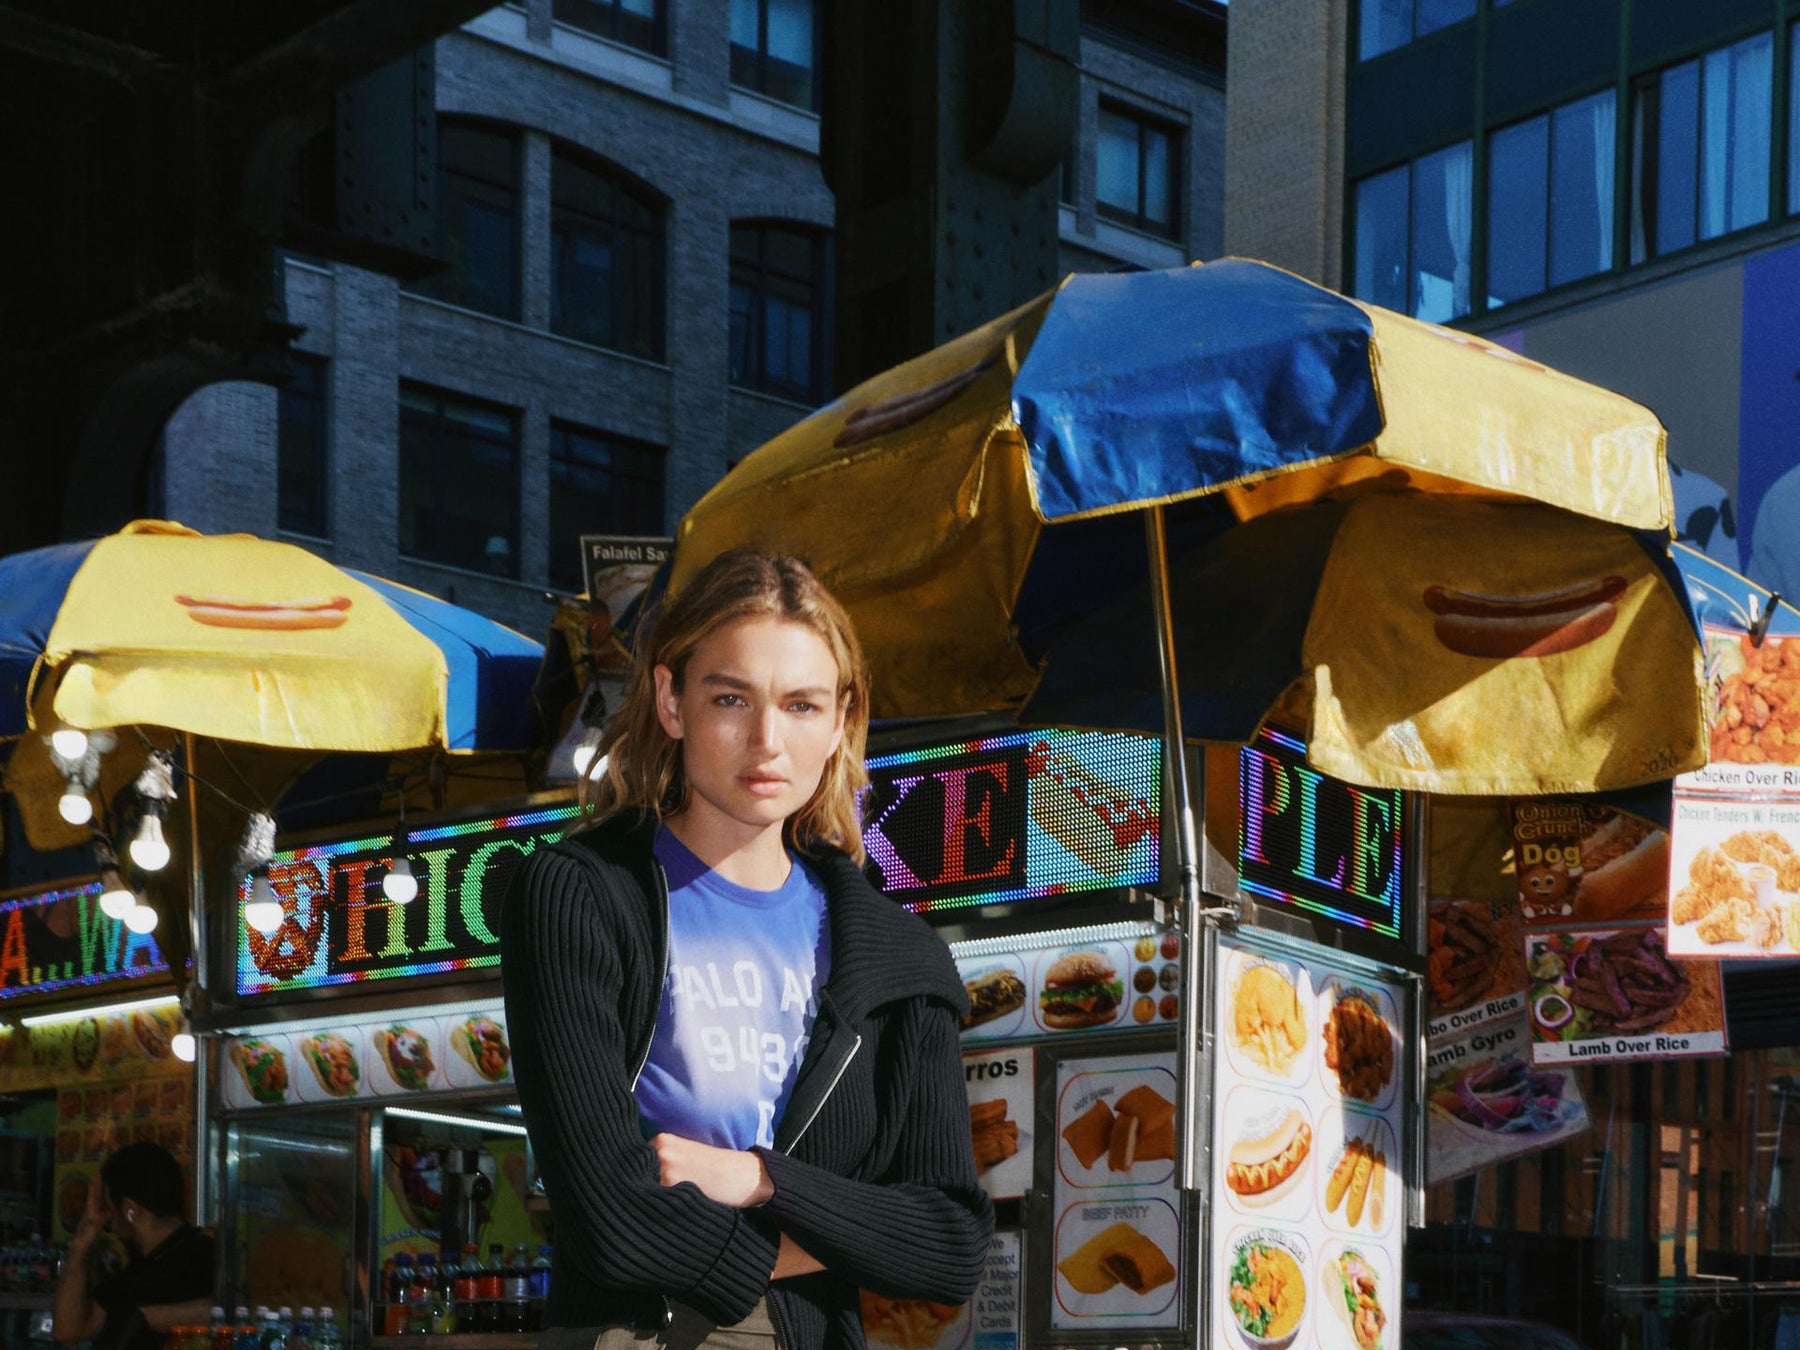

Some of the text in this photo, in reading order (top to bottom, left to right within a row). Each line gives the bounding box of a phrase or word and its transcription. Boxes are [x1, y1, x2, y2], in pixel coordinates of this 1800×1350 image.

[592, 544, 642, 560] Falafel
[1695, 769, 1800, 785] Chicken Over Ri
[1517, 803, 1583, 822] Onion
[1522, 843, 1582, 869] Dog
[1451, 1009, 1481, 1026] Over
[1487, 997, 1518, 1017] Rice
[1470, 1027, 1516, 1054] Gyro
[1569, 1036, 1689, 1057] Lamb Over Rice
[980, 1284, 1013, 1297] Credit
[988, 1301, 1017, 1313] Debit
[980, 1316, 1012, 1328] Cards
